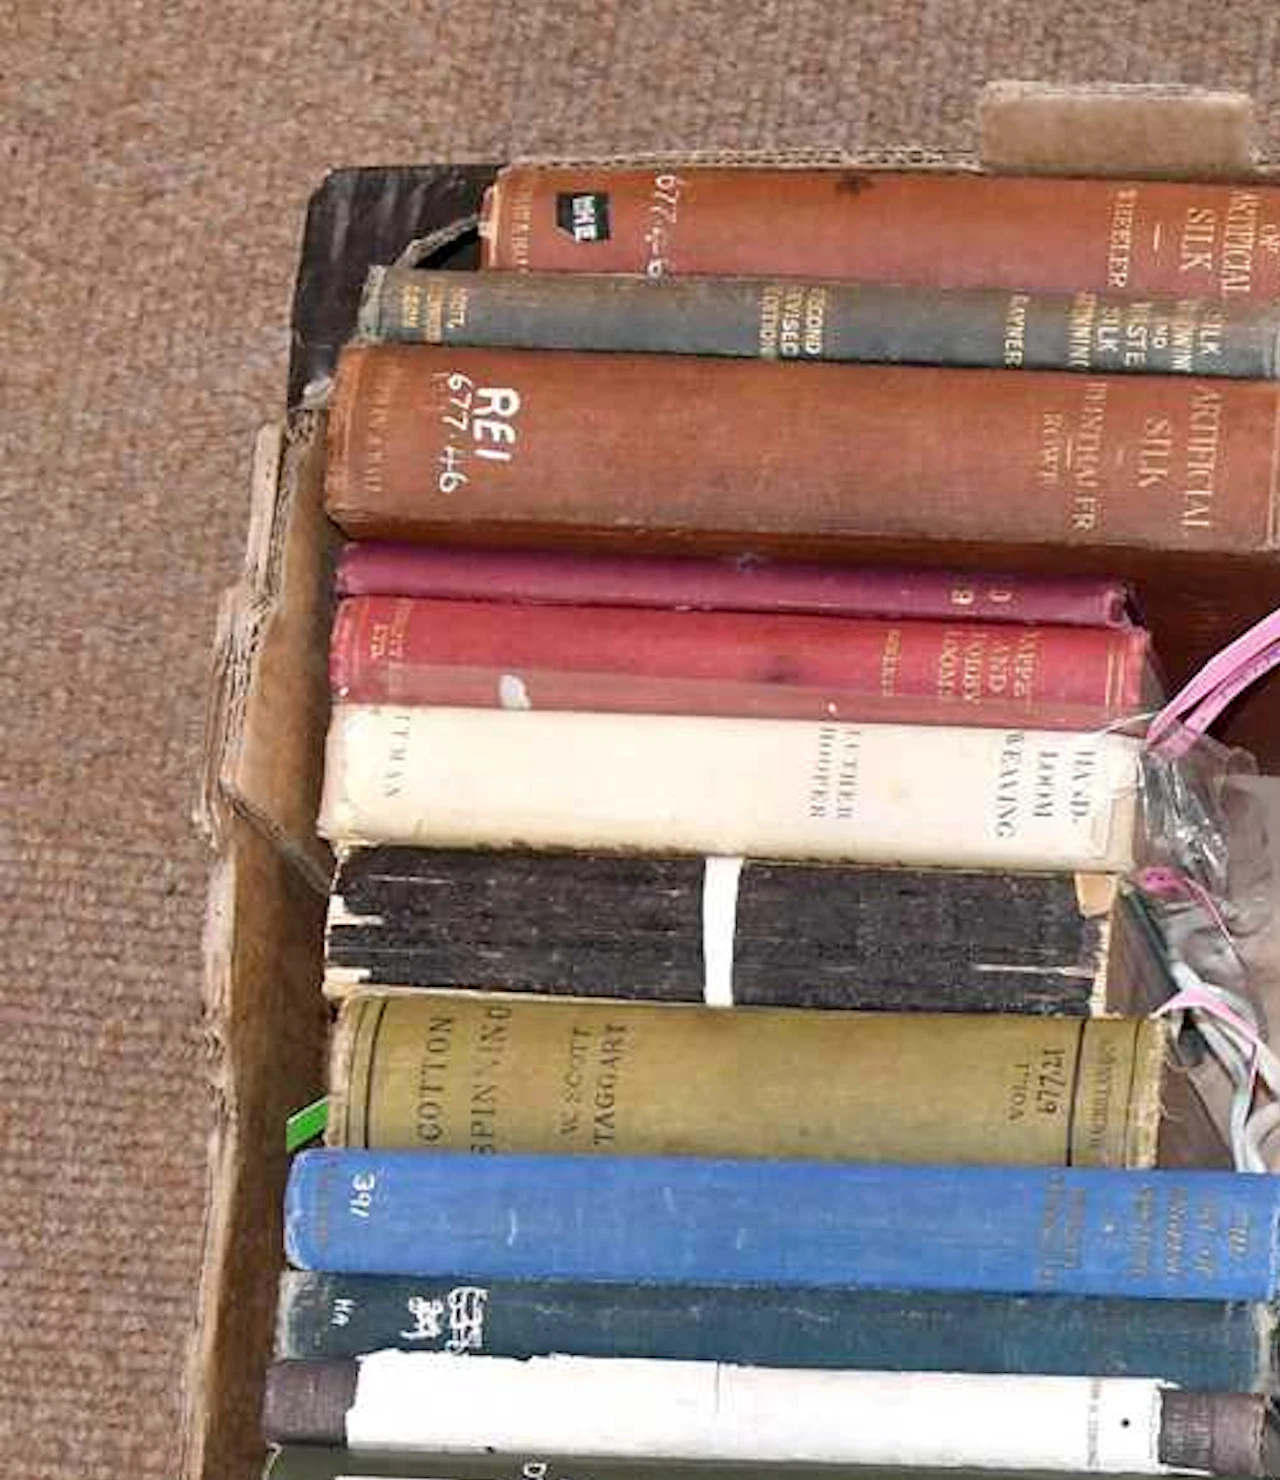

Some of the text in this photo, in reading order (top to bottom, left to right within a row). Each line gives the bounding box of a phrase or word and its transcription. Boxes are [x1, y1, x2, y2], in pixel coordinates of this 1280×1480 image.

[1180, 207, 1215, 271] SILK
[472, 387, 522, 462] REI
[1137, 417, 1172, 488] SILK
[995, 732, 1024, 838] WEAVING
[416, 1016, 453, 1141] COTTON
